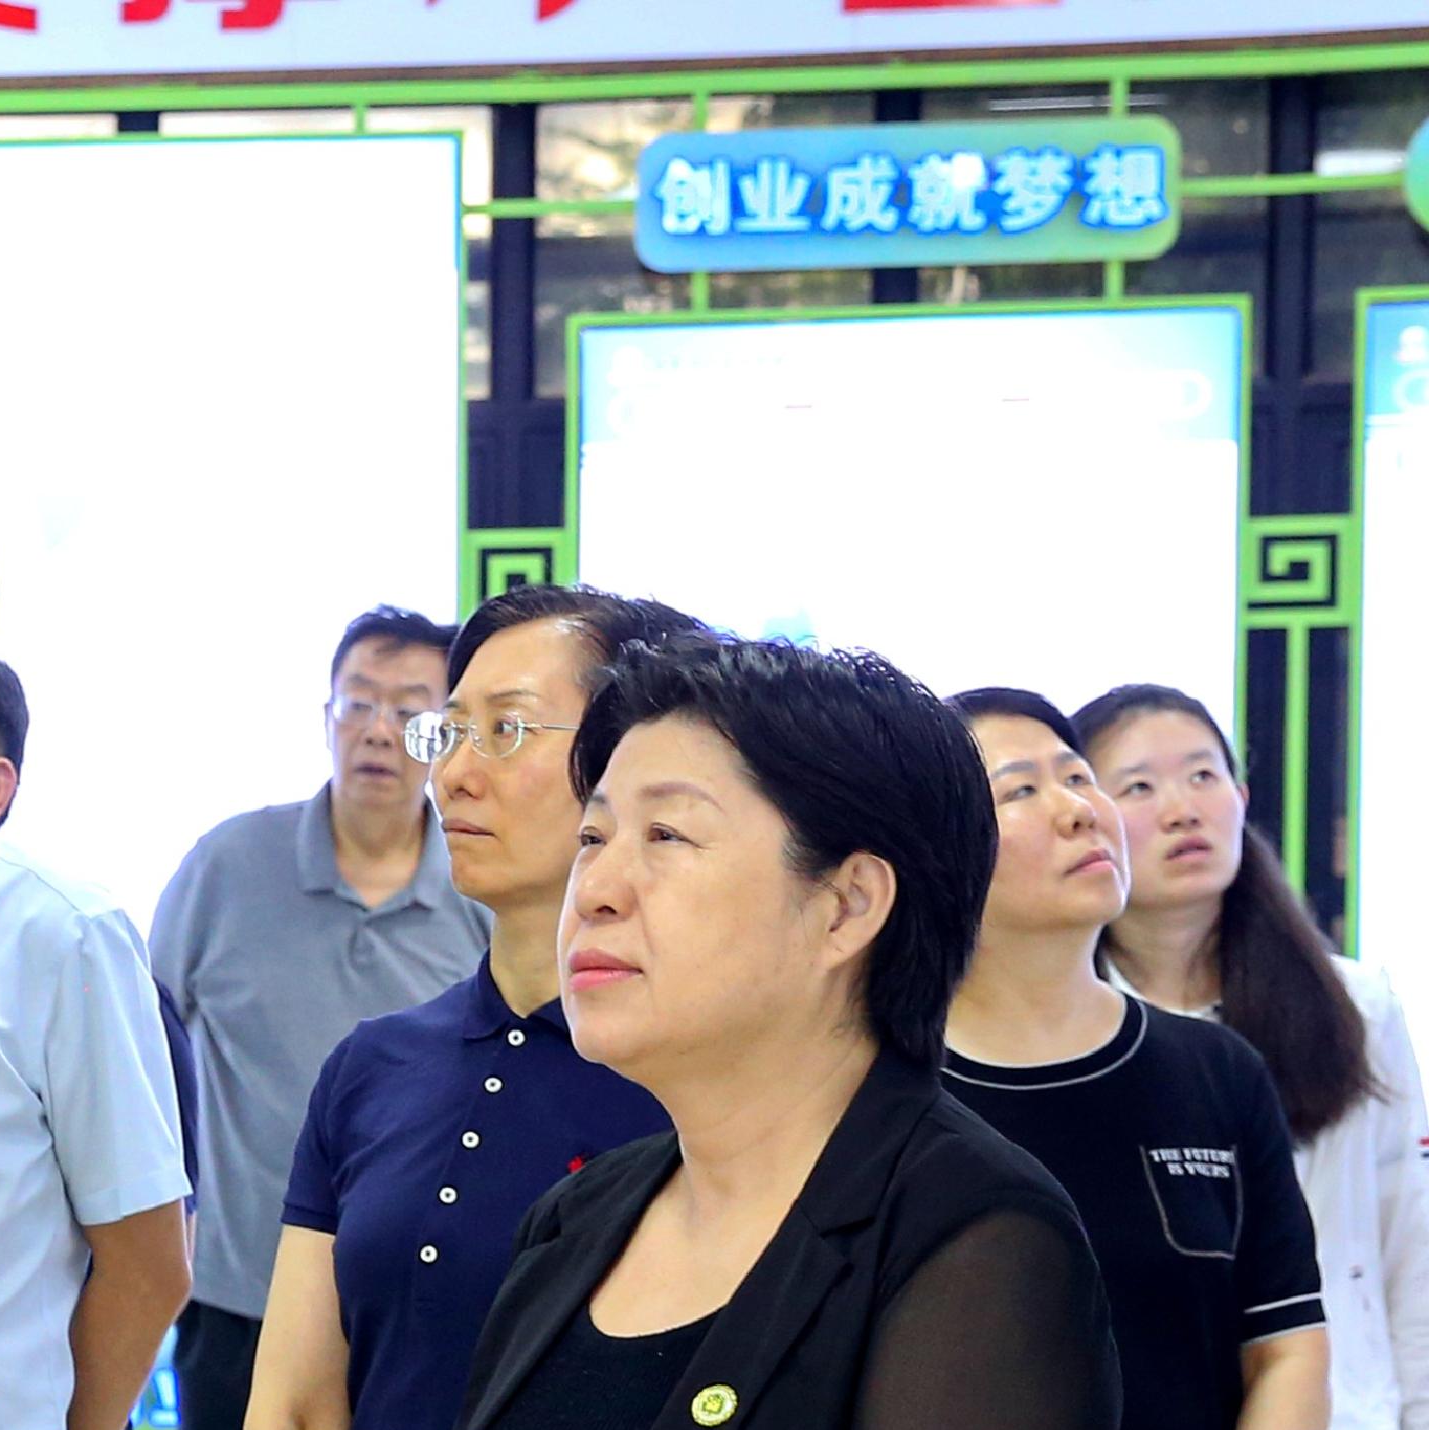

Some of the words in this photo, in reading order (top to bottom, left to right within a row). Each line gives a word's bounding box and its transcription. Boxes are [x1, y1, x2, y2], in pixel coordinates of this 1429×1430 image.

[655, 143, 1169, 235] 创业成就梦想
